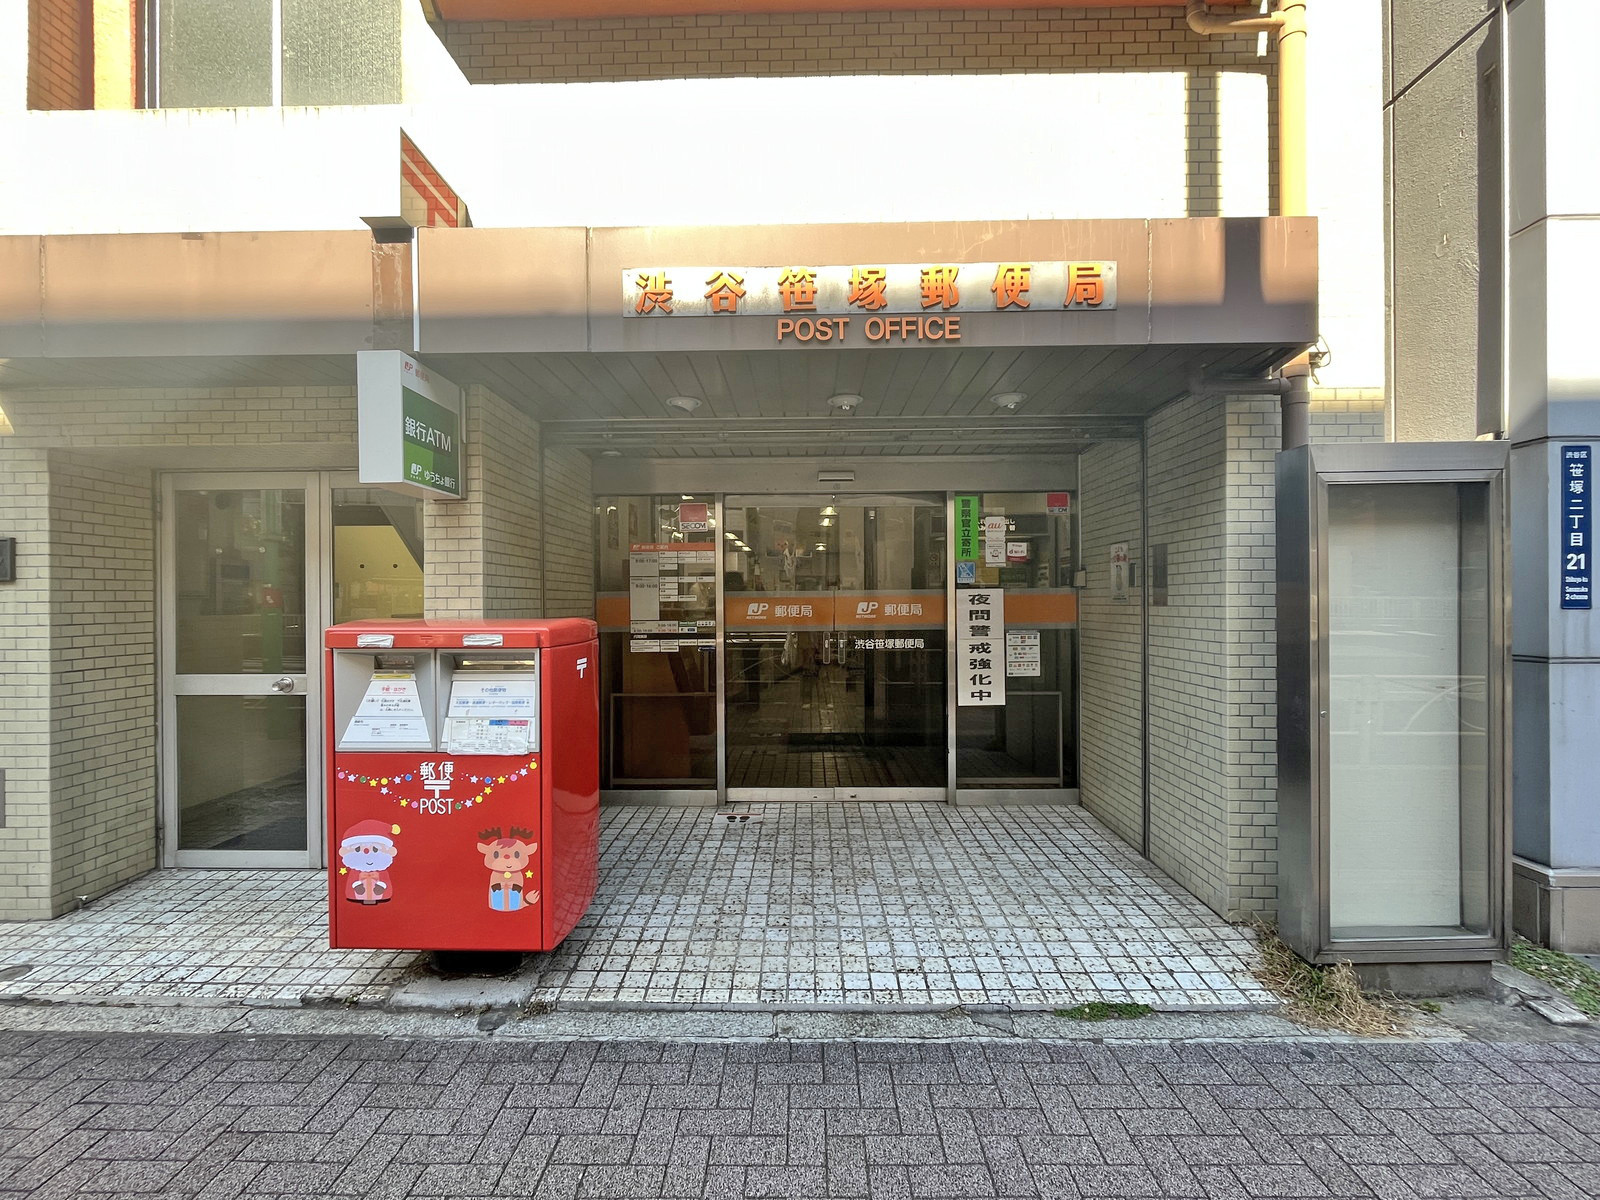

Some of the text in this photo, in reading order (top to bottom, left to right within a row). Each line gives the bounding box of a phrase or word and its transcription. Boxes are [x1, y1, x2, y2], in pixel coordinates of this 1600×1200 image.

[634, 263, 1105, 314] 渋谷笹塚郵便局
[777, 316, 962, 341] POST OFFICE
[404, 416, 451, 453] 銀行ATM
[424, 470, 455, 490] ゆうちょ銀行
[1569, 463, 1584, 547] 笹塚二丁目
[681, 522, 706, 530] SECOM
[961, 499, 972, 558] 警察官立寄所
[987, 522, 1003, 530] au
[1566, 553, 1586, 570] 21
[747, 603, 813, 618] JP 郵便局
[856, 601, 923, 617] JP 郵便局
[854, 638, 925, 650] 渋谷笹塚郵便局
[968, 594, 992, 701] 夜間警戒強化中
[419, 761, 454, 781] 郵便
[419, 798, 454, 815] POST
